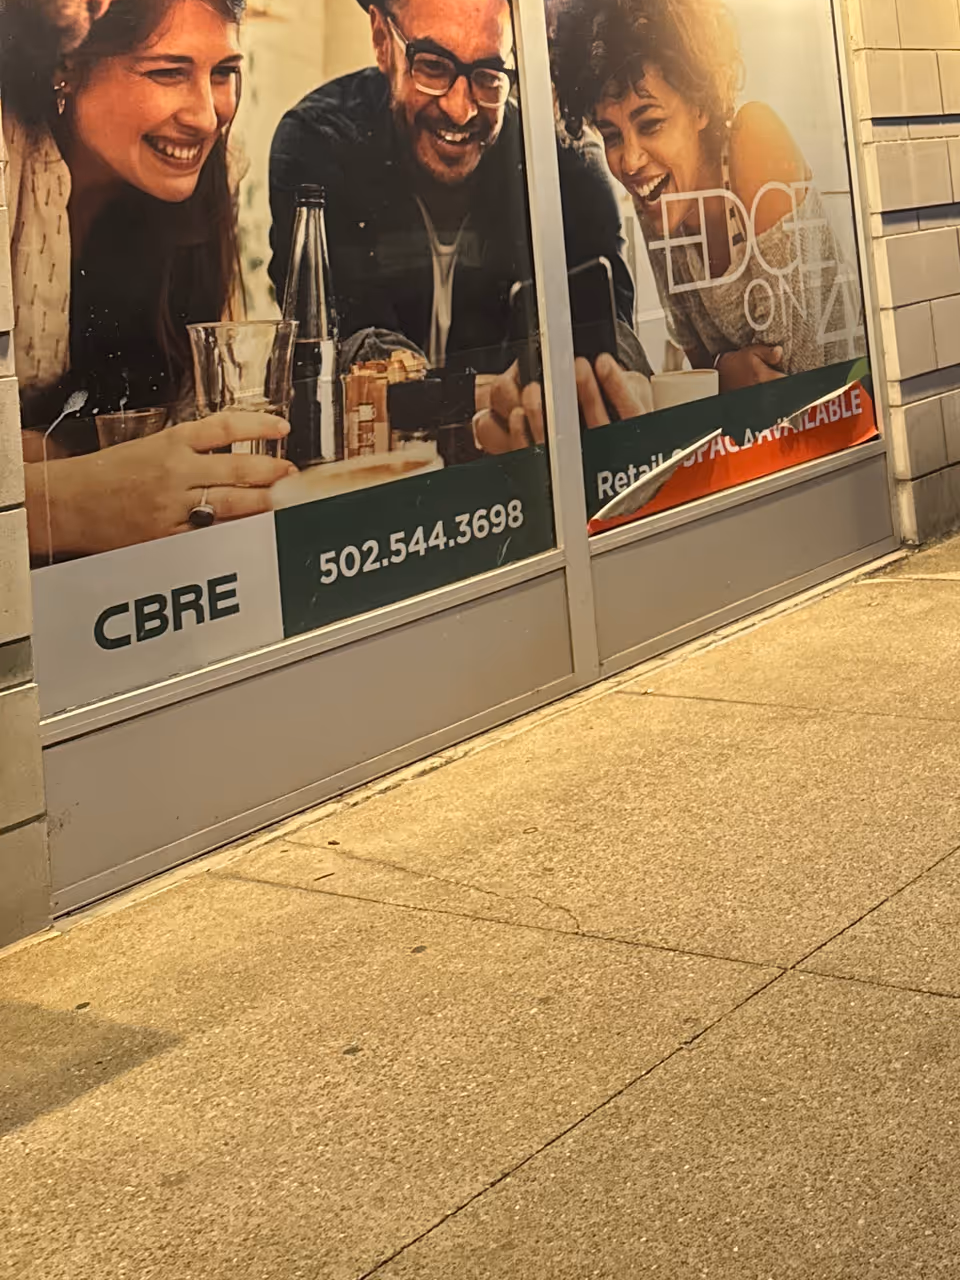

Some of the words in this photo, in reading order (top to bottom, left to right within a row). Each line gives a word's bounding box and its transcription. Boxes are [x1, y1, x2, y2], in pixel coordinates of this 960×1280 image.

[649, 181, 838, 294] EDGE
[743, 273, 808, 331] ON
[817, 273, 866, 362] 4
[320, 499, 525, 585] 502.544.3698
[93, 572, 241, 651] CBRE
